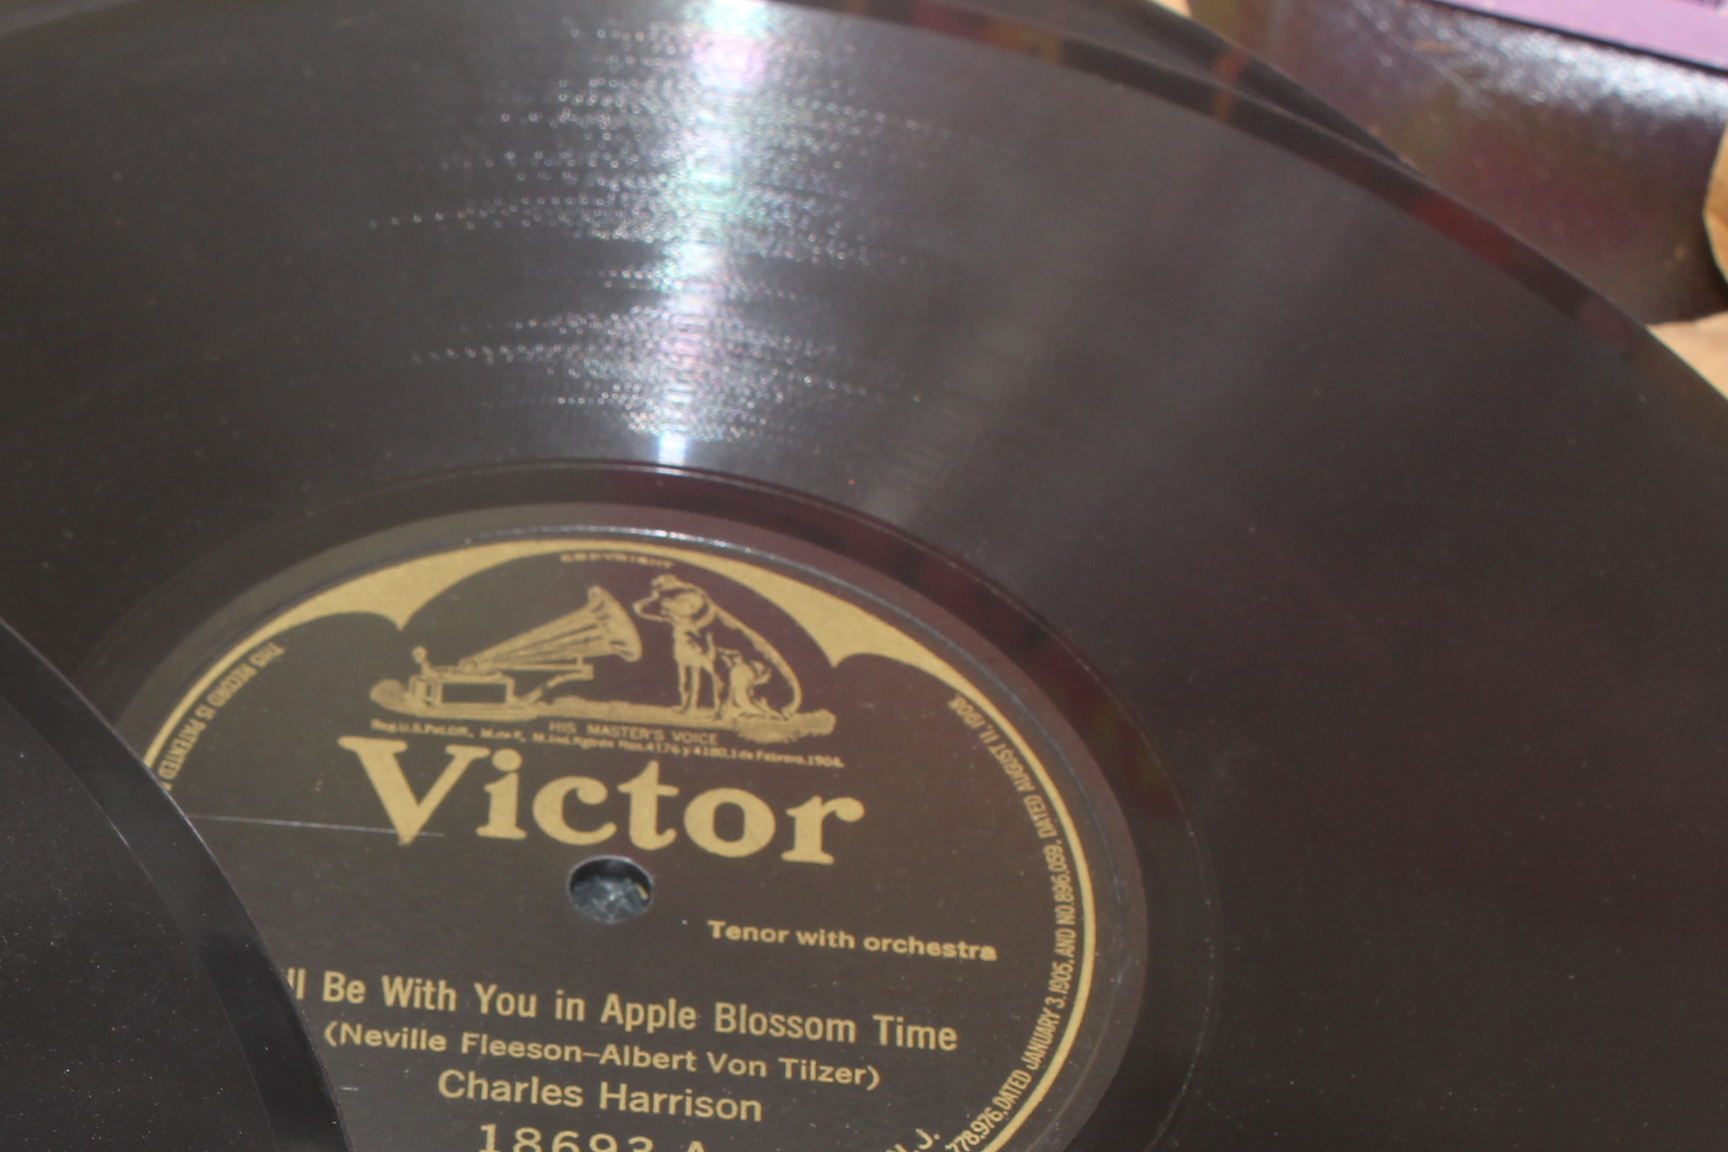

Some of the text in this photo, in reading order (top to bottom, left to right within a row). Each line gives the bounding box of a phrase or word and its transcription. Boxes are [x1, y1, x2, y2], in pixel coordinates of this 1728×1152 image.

[548, 720, 577, 734] HIS
[586, 721, 665, 743] MASTER'S
[671, 730, 719, 746] VOICE
[338, 735, 865, 866] Victor
[1023, 794, 1058, 839] DATED
[707, 919, 998, 962] Tenor with orchestra
[1054, 927, 1077, 958] AND
[322, 970, 366, 1004] Be
[382, 974, 457, 1012] With
[473, 982, 537, 1018] You
[555, 989, 585, 1022] in
[599, 993, 697, 1034] Apple
[714, 1000, 857, 1044] Blossom
[873, 1013, 958, 1051] Time
[324, 1020, 447, 1052] (Neville
[706, 1051, 767, 1078] Von
[778, 1056, 881, 1091] Tilzer)
[1021, 1007, 1062, 1071] JANUARY
[438, 1069, 763, 1122] Charles Harrison
[992, 1069, 1033, 1116] DATED
